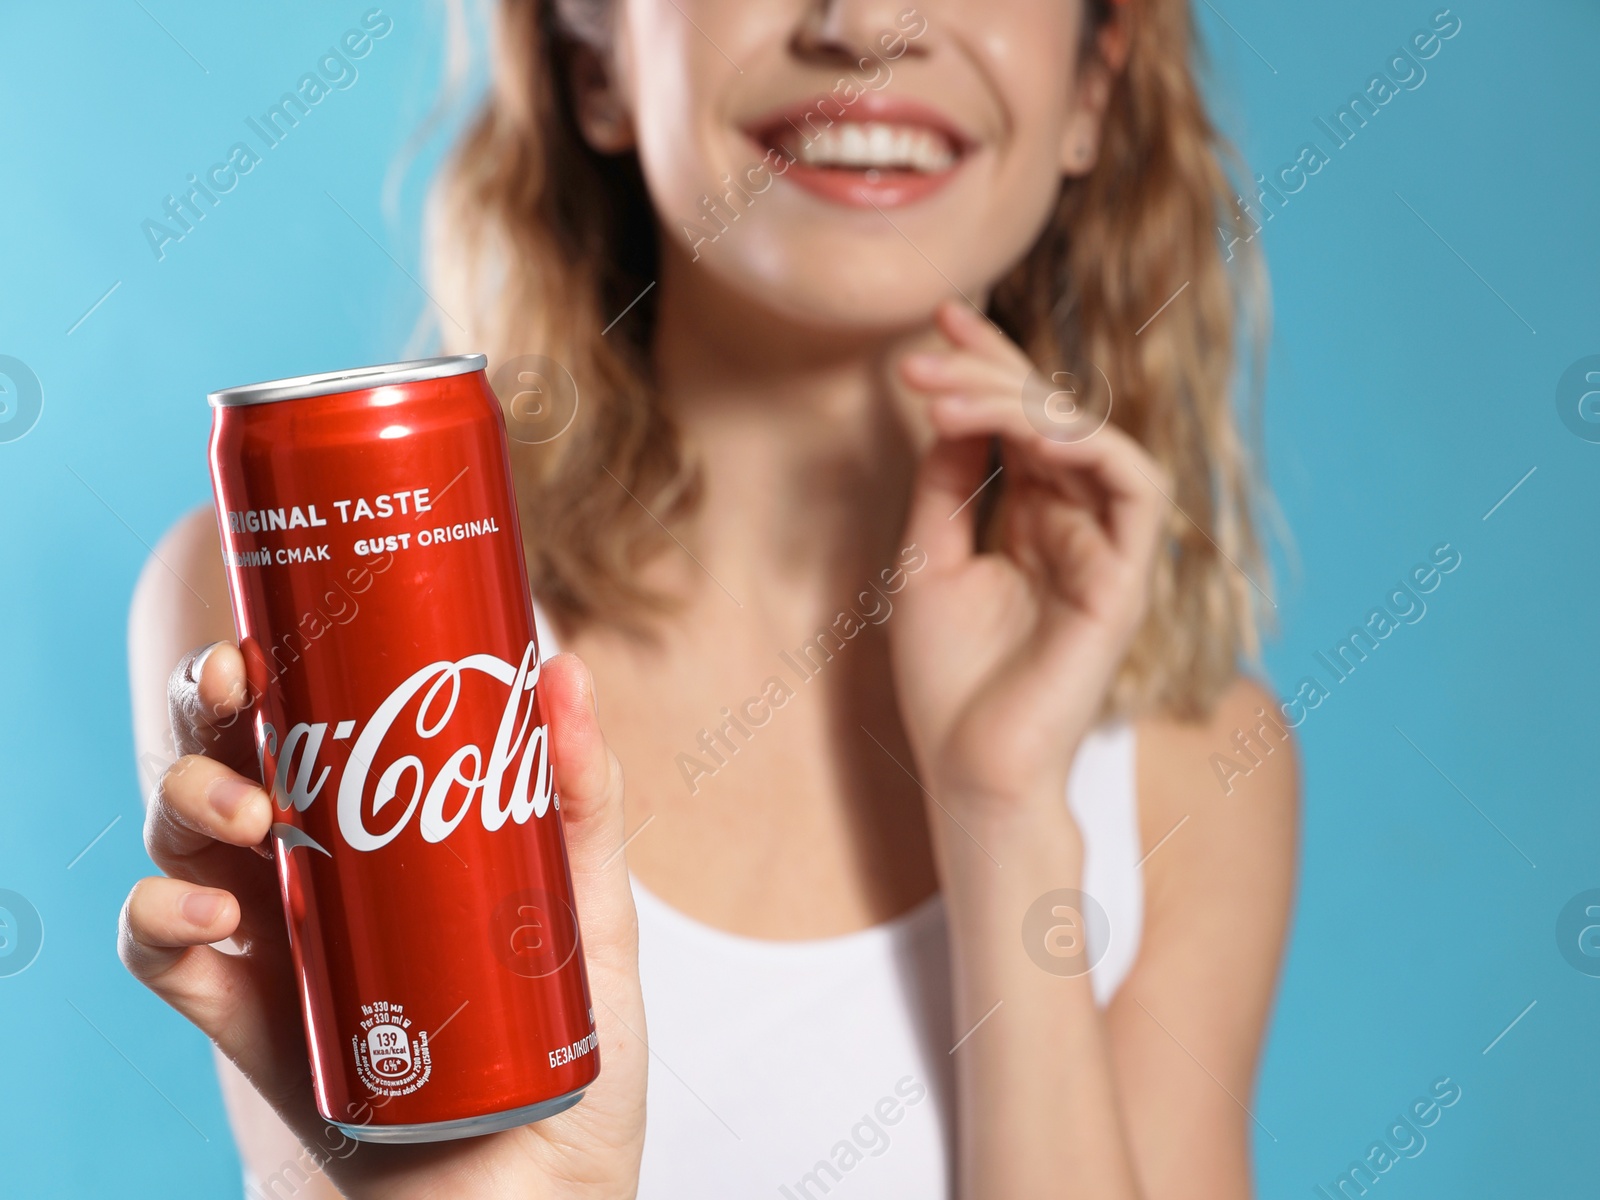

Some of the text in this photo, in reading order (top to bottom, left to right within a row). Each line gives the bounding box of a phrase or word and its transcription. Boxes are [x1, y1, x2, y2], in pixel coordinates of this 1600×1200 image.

[229, 488, 432, 533] RIGINAL TASTE
[353, 517, 499, 557] GUST ORIGINAL
[275, 544, 331, 565] СМАК
[361, 1001, 403, 1016] На 330 мл
[360, 1012, 403, 1031] Per 330 ml
[376, 1032, 397, 1047] 139
